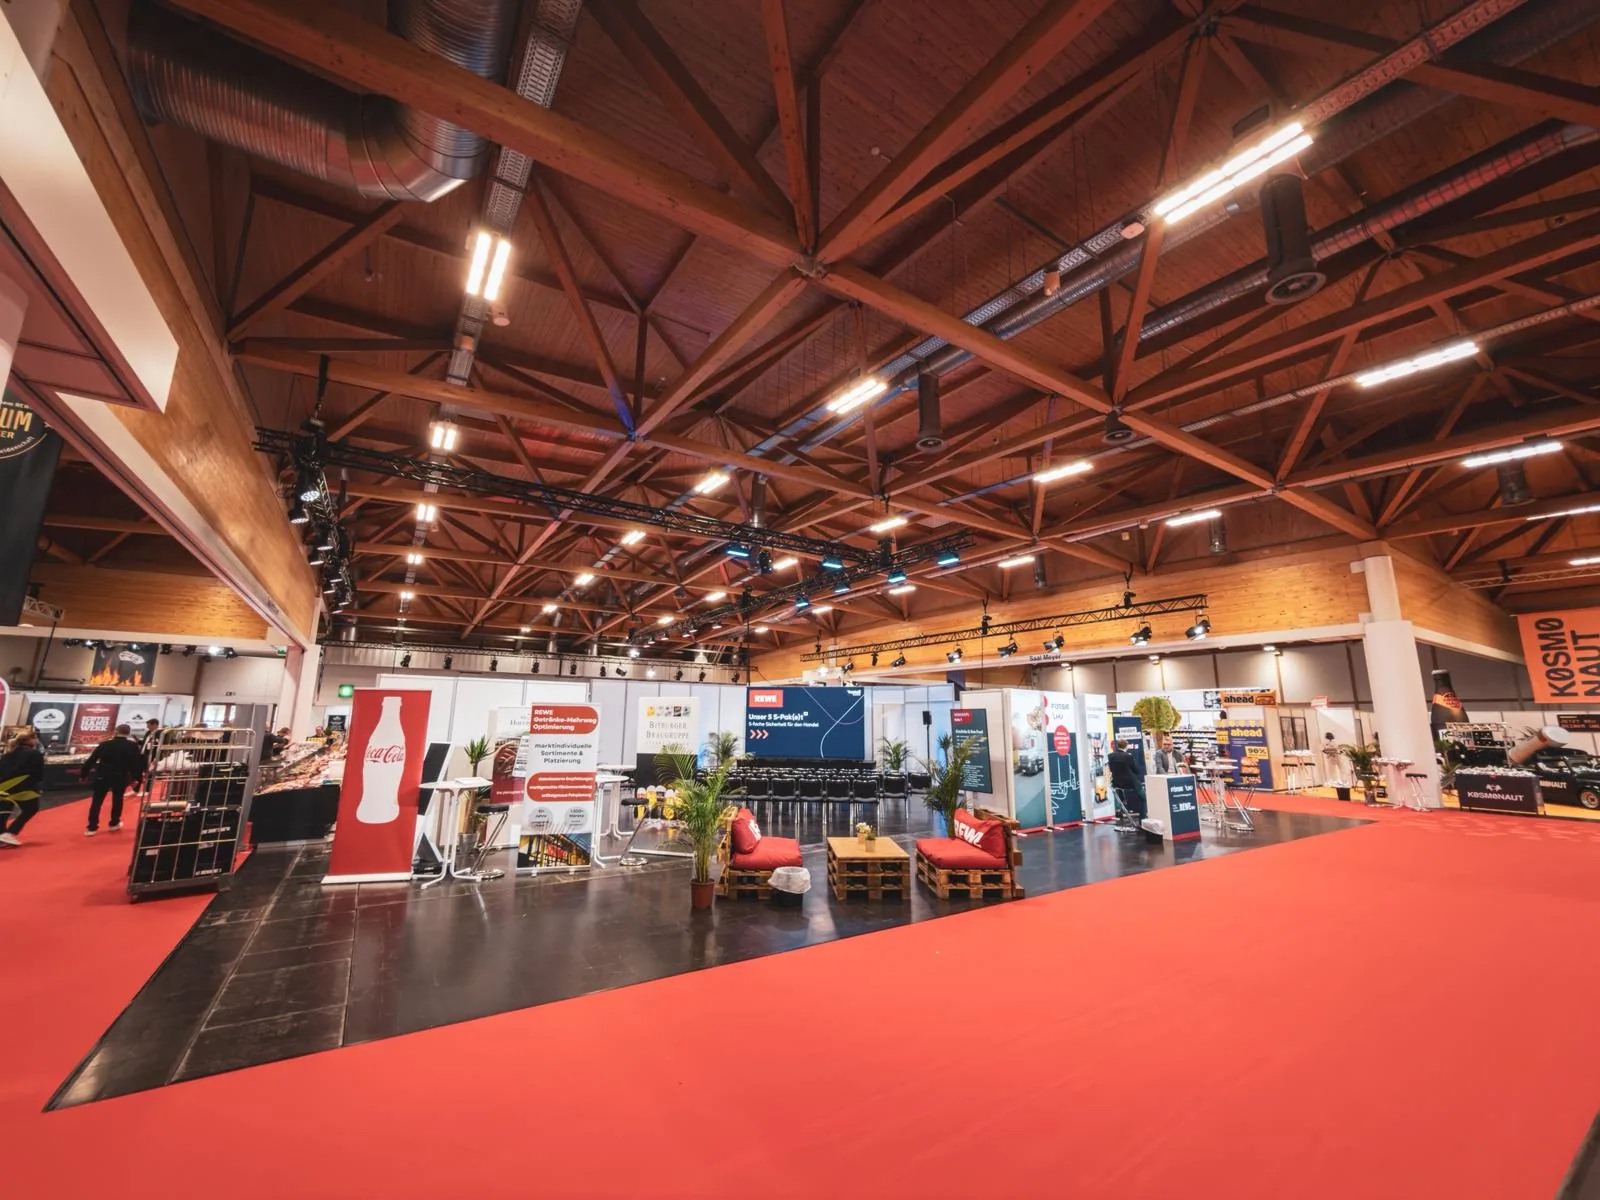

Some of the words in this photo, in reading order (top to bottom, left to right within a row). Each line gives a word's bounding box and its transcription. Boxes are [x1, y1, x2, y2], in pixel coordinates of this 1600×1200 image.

[754, 694, 777, 703] REWE
[1223, 695, 1255, 704] ahead
[1230, 728, 1263, 737] ahead
[1467, 791, 1525, 802] KØSMØNAUT
